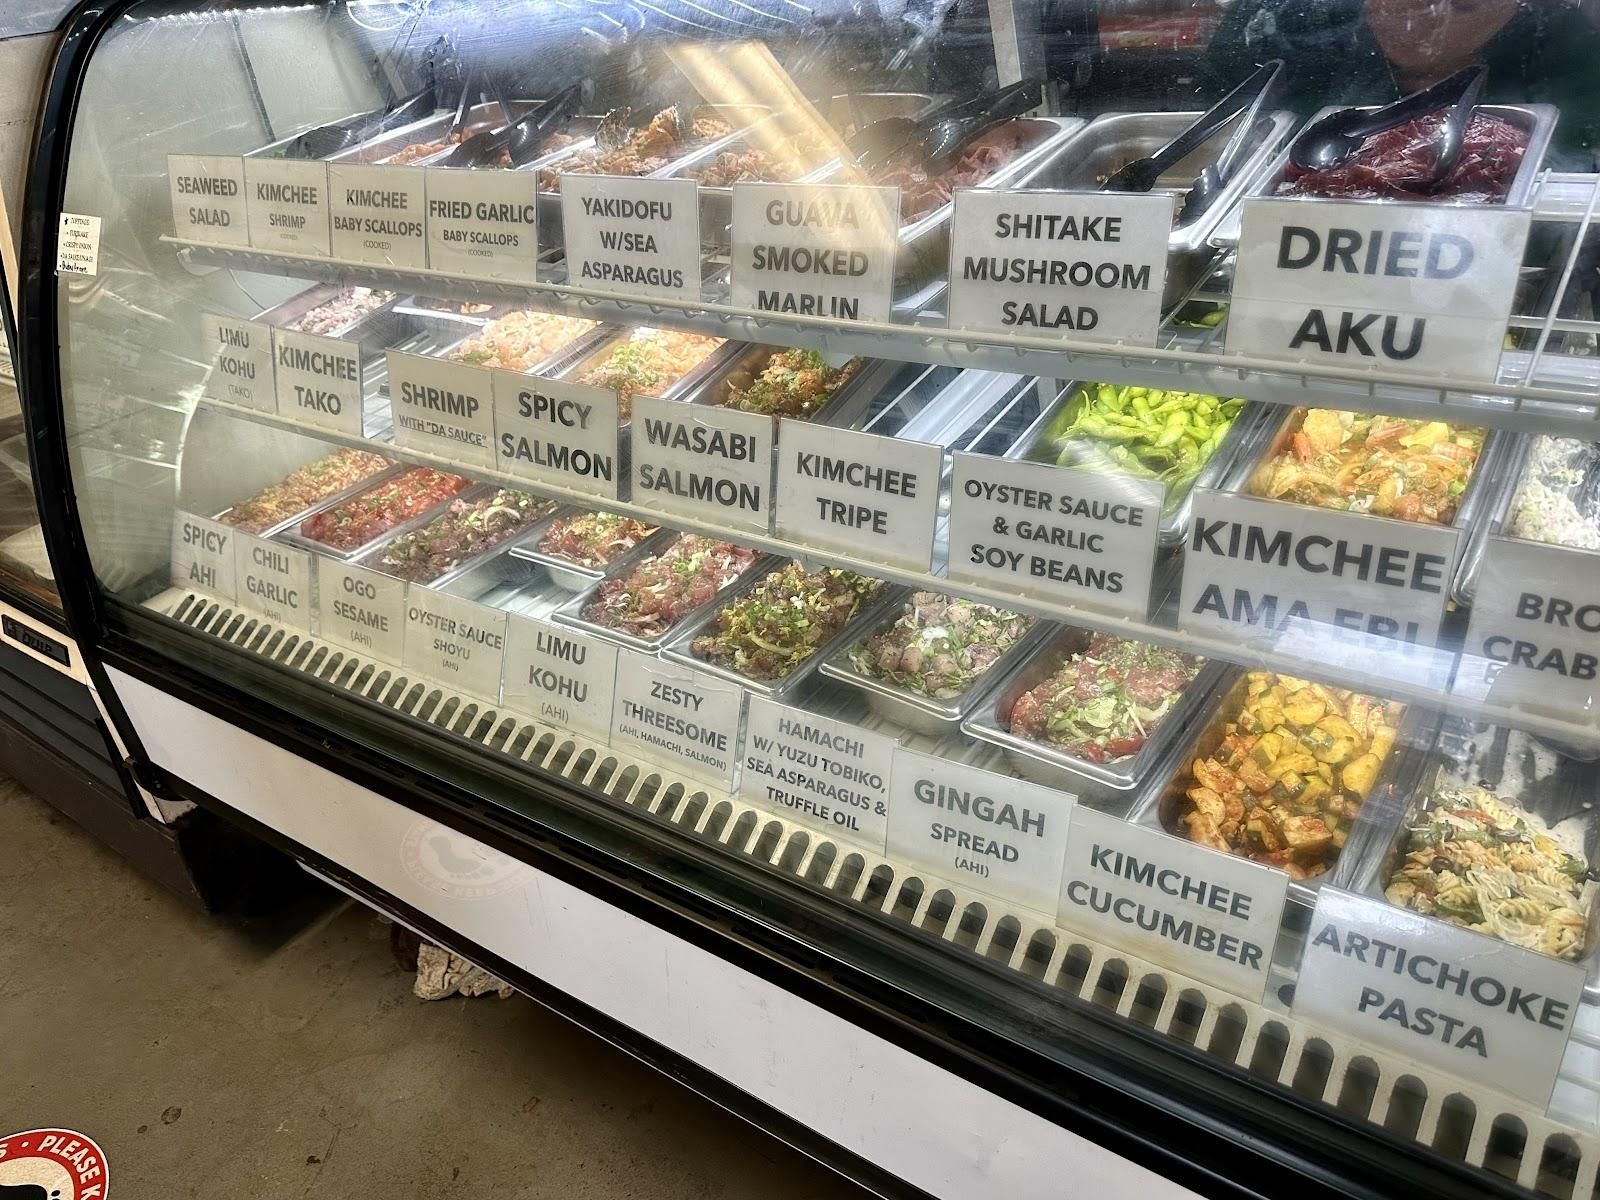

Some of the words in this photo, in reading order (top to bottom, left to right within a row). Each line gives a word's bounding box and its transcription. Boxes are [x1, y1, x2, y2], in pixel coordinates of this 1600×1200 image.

[177, 176, 238, 197] SEAWEED
[257, 183, 318, 205] KIMCHEE
[346, 189, 408, 210] KIMCHEE
[189, 207, 231, 227] SALAD
[269, 213, 306, 229] SHRIMP
[429, 200, 472, 220] FRIED
[476, 202, 535, 225] GARLIC
[582, 197, 672, 222] YAKIDOFU
[766, 200, 859, 229] GUAVA
[334, 216, 362, 232] BABY
[365, 218, 423, 238] SCALLOPS
[443, 230, 468, 243] BABY
[470, 232, 519, 247] SCALLOPS
[600, 231, 658, 254] W/SEA
[994, 213, 1122, 243] SHITAKE
[363, 240, 392, 251] (COOKED)
[752, 245, 869, 277] SMOKED
[1276, 225, 1475, 280] DRIED
[581, 260, 684, 289] ASPARAGUS
[963, 256, 1151, 291] MUSHROOM
[757, 290, 859, 320] MARLIN
[1001, 301, 1099, 330] SALAD
[219, 327, 249, 349] LIMU
[1288, 309, 1426, 360] AKU
[219, 356, 255, 379] KOHU
[278, 344, 358, 381] KIMCHEE
[228, 384, 252, 401] (TAKO)
[294, 385, 341, 416] TAKO
[401, 381, 479, 419] SHRIMP
[518, 391, 593, 430] SPICY
[399, 415, 425, 432] WITH
[426, 421, 446, 437] "DA
[447, 425, 487, 447] SAUCE"
[644, 417, 756, 463] WASABI
[501, 432, 612, 482] SALMON
[639, 463, 760, 512] SALMON
[797, 451, 917, 498] KIMCHEE
[816, 497, 888, 535] TRIPE
[964, 479, 1053, 512] OYSTER
[1058, 495, 1144, 527] SAUCE
[183, 523, 227, 555] SPICY
[992, 516, 1009, 536] &
[1015, 520, 1105, 554] GARLIC
[253, 547, 289, 575] CHILI
[970, 543, 1024, 572] SOY
[1030, 555, 1124, 594] BEANS
[1192, 517, 1447, 594] KIMCHEE
[190, 562, 216, 589] AHI
[343, 576, 376, 599] OGO
[246, 575, 298, 609] GARLIC
[264, 608, 282, 623] (AHI)
[333, 600, 389, 632] SESAME
[1192, 583, 1313, 637] AMA
[350, 630, 372, 648] (AHI)
[409, 607, 456, 635] OYSTER
[459, 623, 502, 650] SAUCE
[433, 638, 470, 660] SHOYU
[536, 632, 587, 665] LIMU
[1483, 635, 1598, 680] CRAB
[442, 659, 459, 672] (AHI)
[529, 664, 588, 703] KOHU
[650, 680, 704, 712] ZESTY
[541, 701, 569, 724] (AHI)
[622, 699, 728, 752] THREESOME
[619, 723, 640, 741] (AHI,
[640, 730, 684, 755] HAMACHI,
[685, 747, 727, 772] SALMON)
[778, 718, 864, 758] HAMACHI
[753, 735, 774, 753] W/
[776, 744, 818, 769] YUZU
[821, 757, 886, 794] TOBIKO,
[747, 757, 774, 778] SEA
[776, 767, 870, 812] ASPARAGUS
[874, 800, 887, 817] &
[766, 785, 829, 821] TRUFFLE
[832, 811, 860, 832] OIL
[913, 779, 1045, 837] GINGAH
[930, 823, 1019, 863] SPREAD
[954, 856, 989, 878] (AHI)
[1090, 843, 1252, 921] KIMCHEE
[1066, 879, 1263, 971] CUCUMBER
[1312, 923, 1569, 1031] ARTICHOKE
[1357, 986, 1488, 1058] PASTA
[36, 1135, 100, 1184] PLEASE
